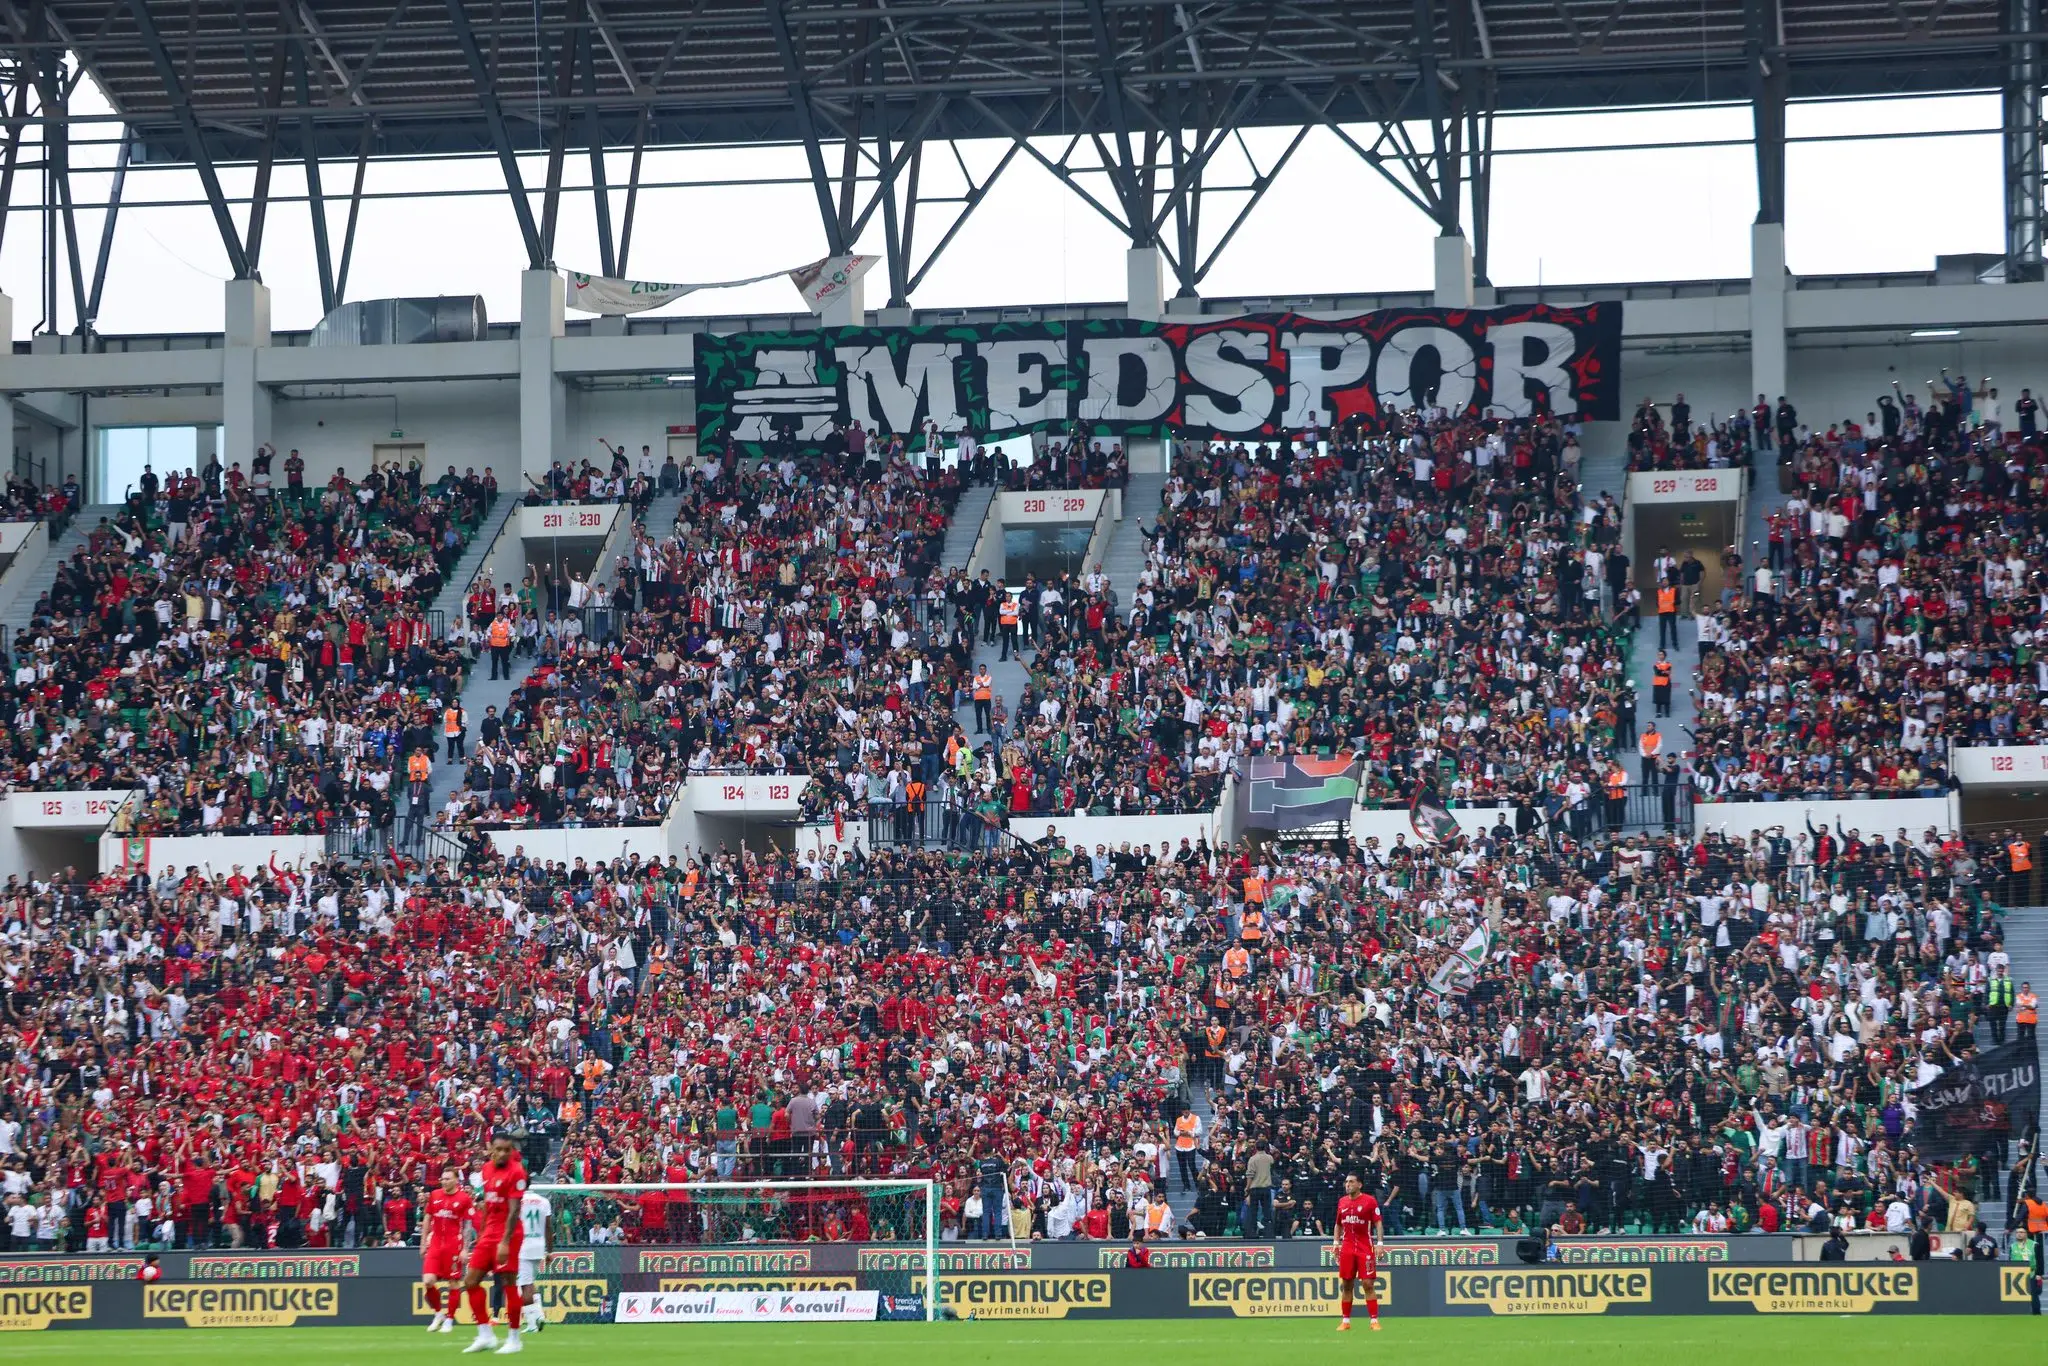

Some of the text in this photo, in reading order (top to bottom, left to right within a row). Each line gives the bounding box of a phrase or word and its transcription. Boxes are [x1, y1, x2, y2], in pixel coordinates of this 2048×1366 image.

[730, 321, 1579, 441] AMEDSPOR
[1654, 478, 1717, 493] 229 228
[1024, 498, 1085, 513] 230 229
[543, 513, 601, 528] 231 230
[1991, 756, 2013, 771] 122
[723, 785, 789, 800] 124 123
[42, 800, 107, 815] 125 124
[651, 1296, 716, 1315] Karavil
[780, 1296, 846, 1313] Karavil
[1249, 1303, 1328, 1315] gayrimenkul
[1507, 1300, 1588, 1313] gayrimenkul
[1771, 1299, 1853, 1310] gayrimenkul
